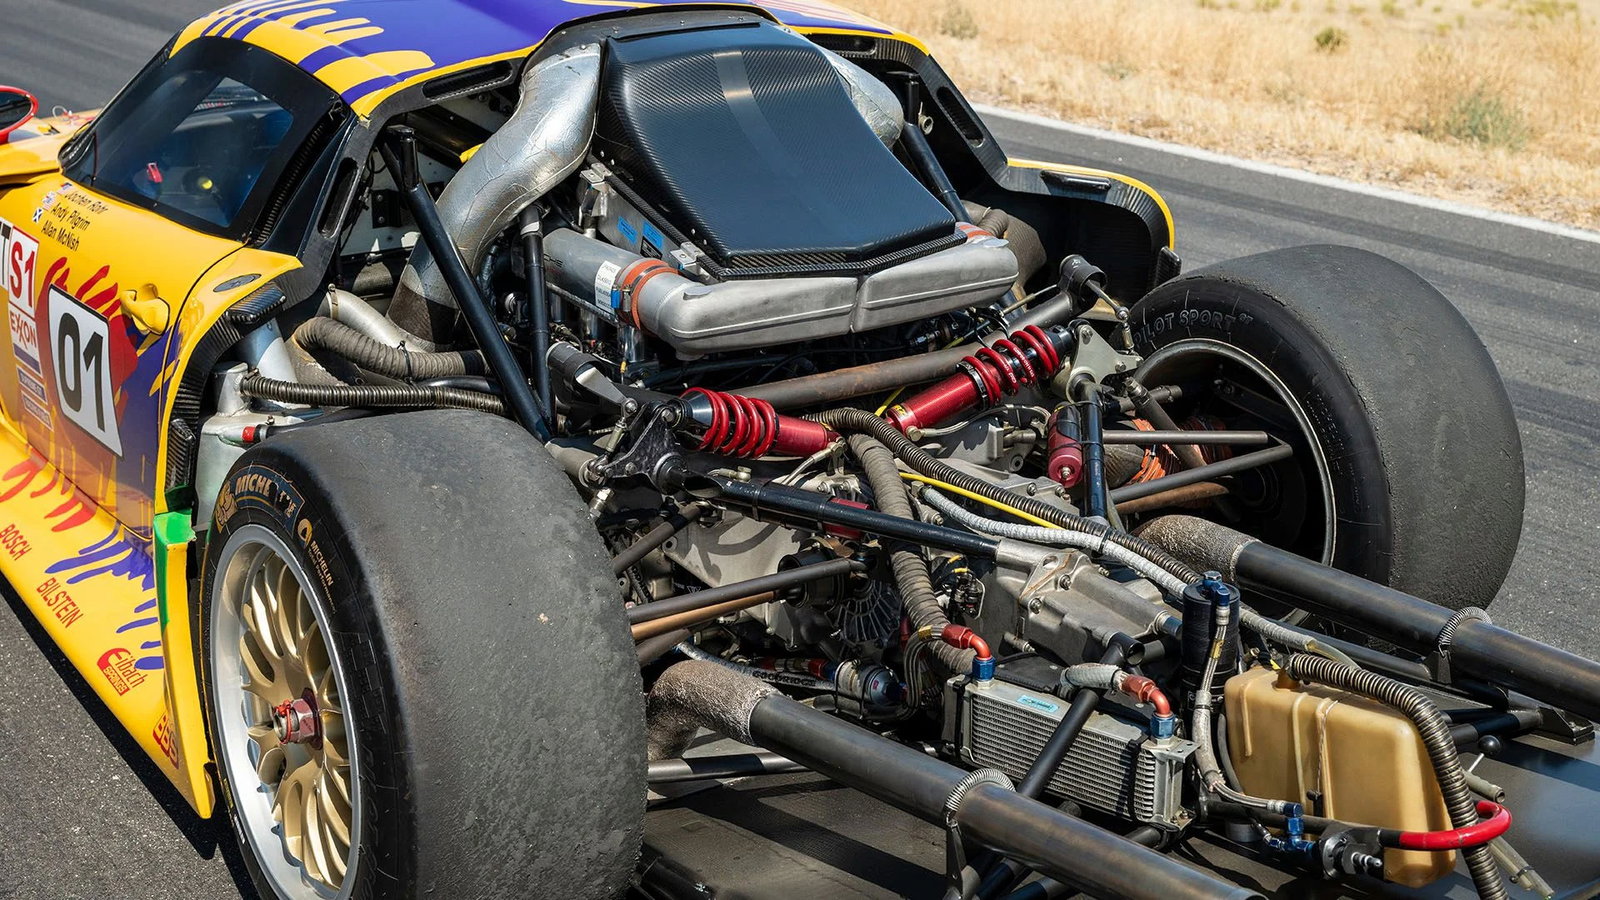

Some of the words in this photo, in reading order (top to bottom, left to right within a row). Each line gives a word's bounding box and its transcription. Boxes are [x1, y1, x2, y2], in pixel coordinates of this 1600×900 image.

[41, 220, 57, 238] Allan
[56, 227, 79, 251] McNish
[51, 202, 69, 222] Andy
[67, 210, 90, 231] Pilgrim
[10, 311, 37, 350] EXXON
[1179, 308, 1237, 331] SPORT
[58, 312, 105, 432] 01
[0, 523, 32, 561] BOSCH
[310, 540, 334, 587] MICHELIN
[36, 577, 84, 628] BILSTEIN
[97, 647, 148, 688] Eibach
[153, 711, 179, 769] BBS
